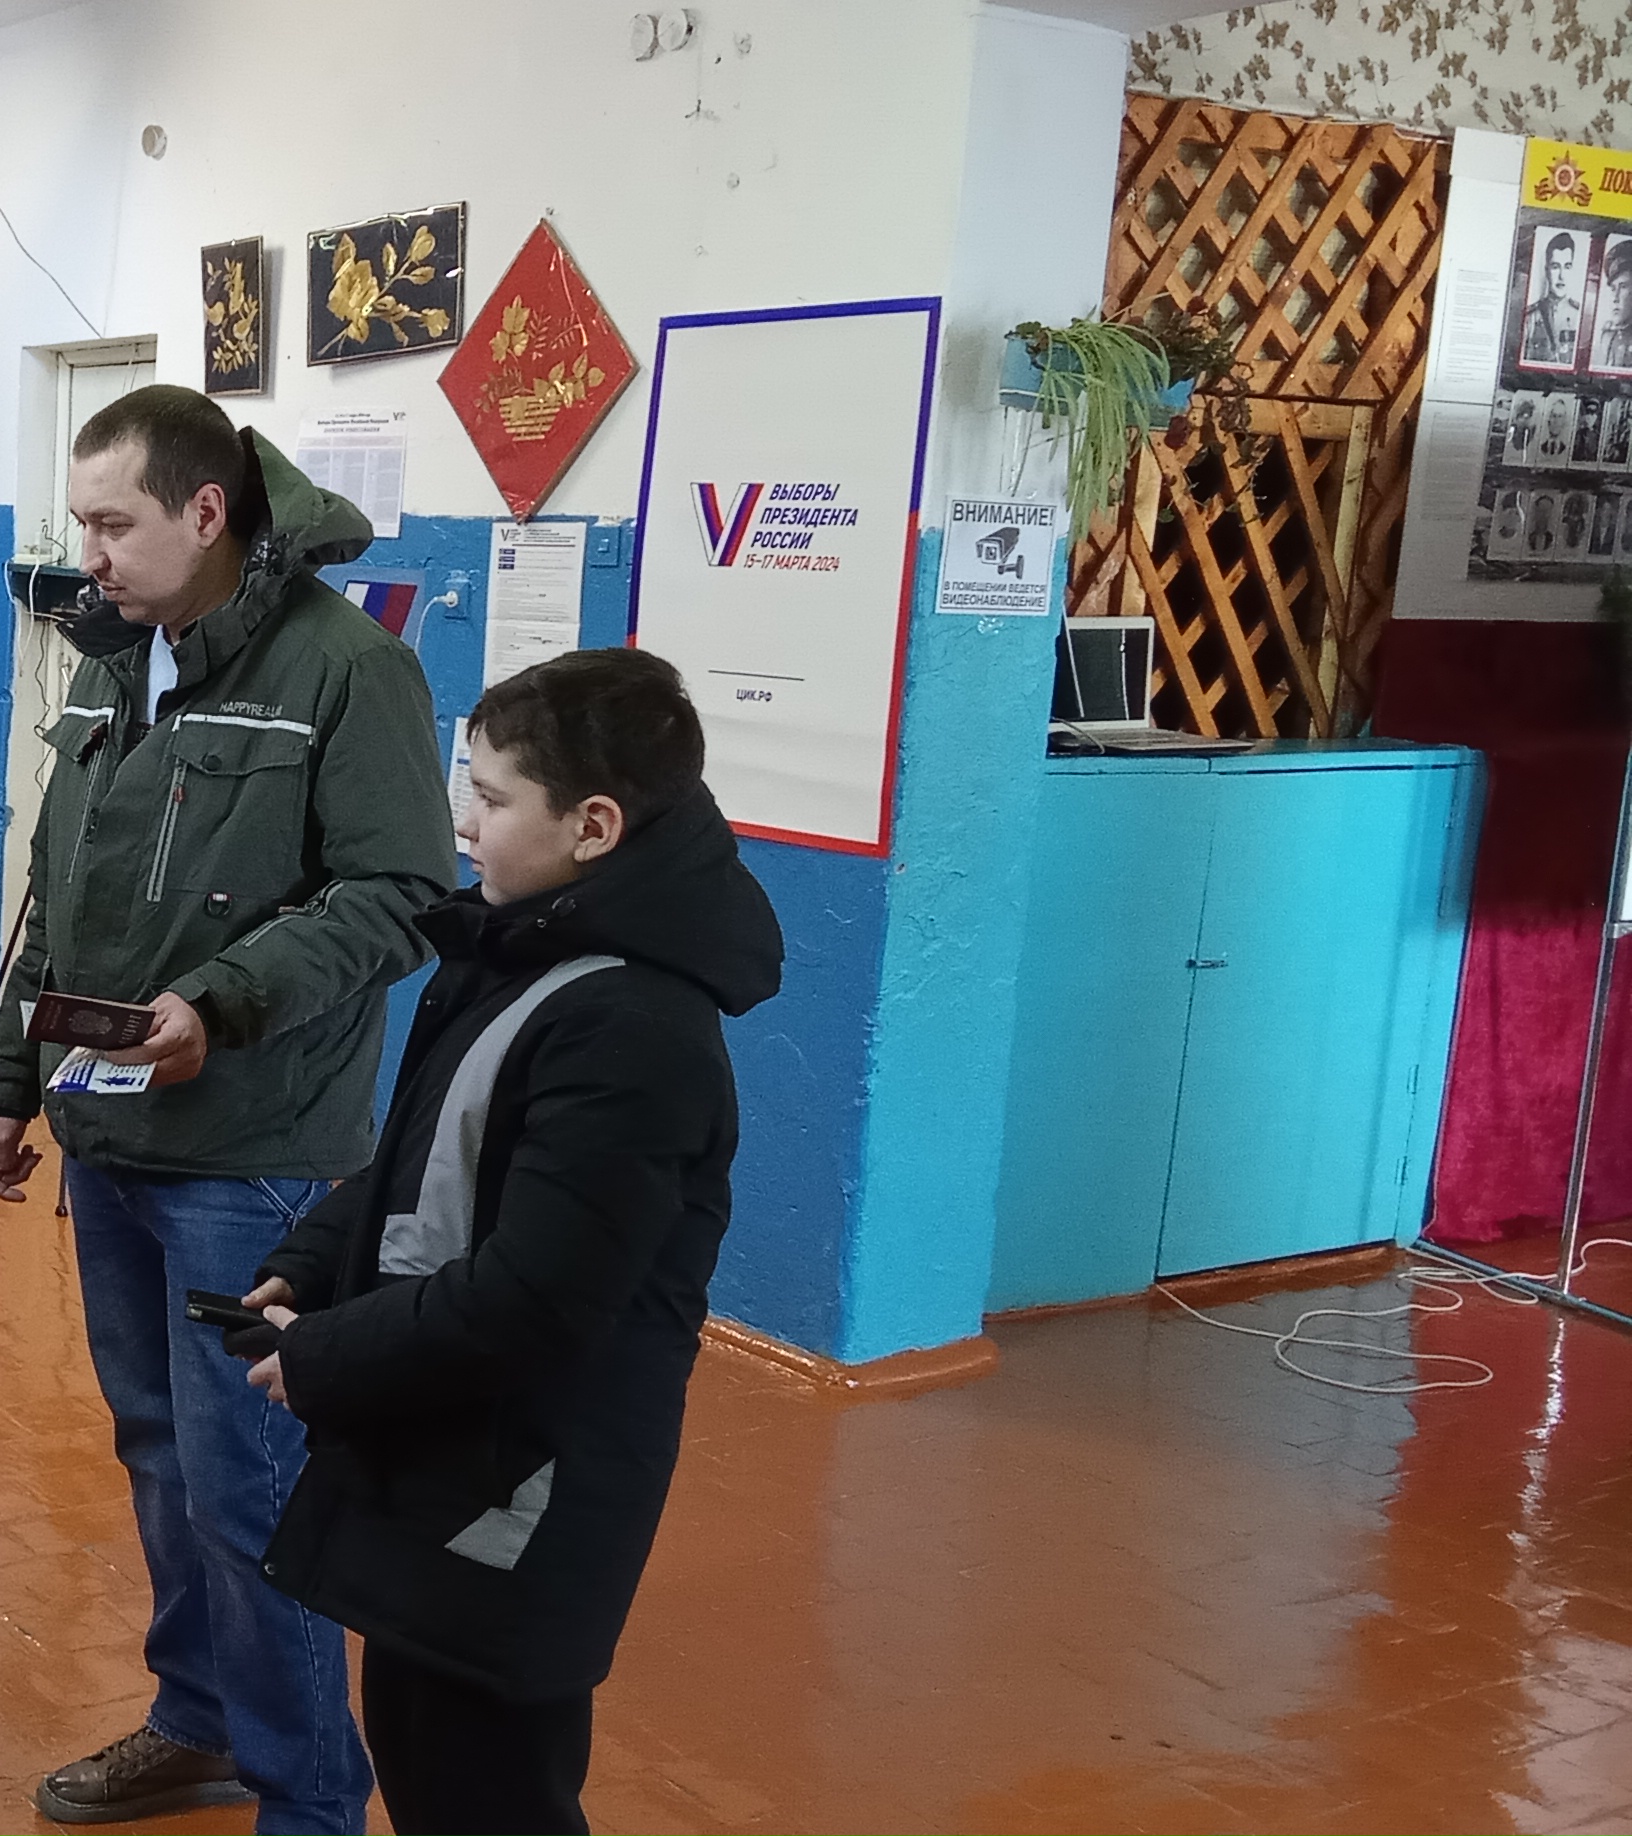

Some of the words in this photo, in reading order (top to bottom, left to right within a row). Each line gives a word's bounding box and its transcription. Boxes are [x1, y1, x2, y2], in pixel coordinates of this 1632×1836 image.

[769, 483, 840, 501] ВЫБОРЫ
[759, 507, 858, 528] ПРЕЗИДЕНТА
[953, 503, 1054, 526] ВНИМАНИЕ!
[751, 531, 814, 550] РОССИИ
[772, 555, 812, 571] МАРТА
[811, 555, 840, 572] 2024
[944, 581, 950, 591] В
[942, 593, 1045, 607] ВИДЕОНАБЛЮДЕНИЕ
[736, 688, 773, 702] ЦИК.РФ
